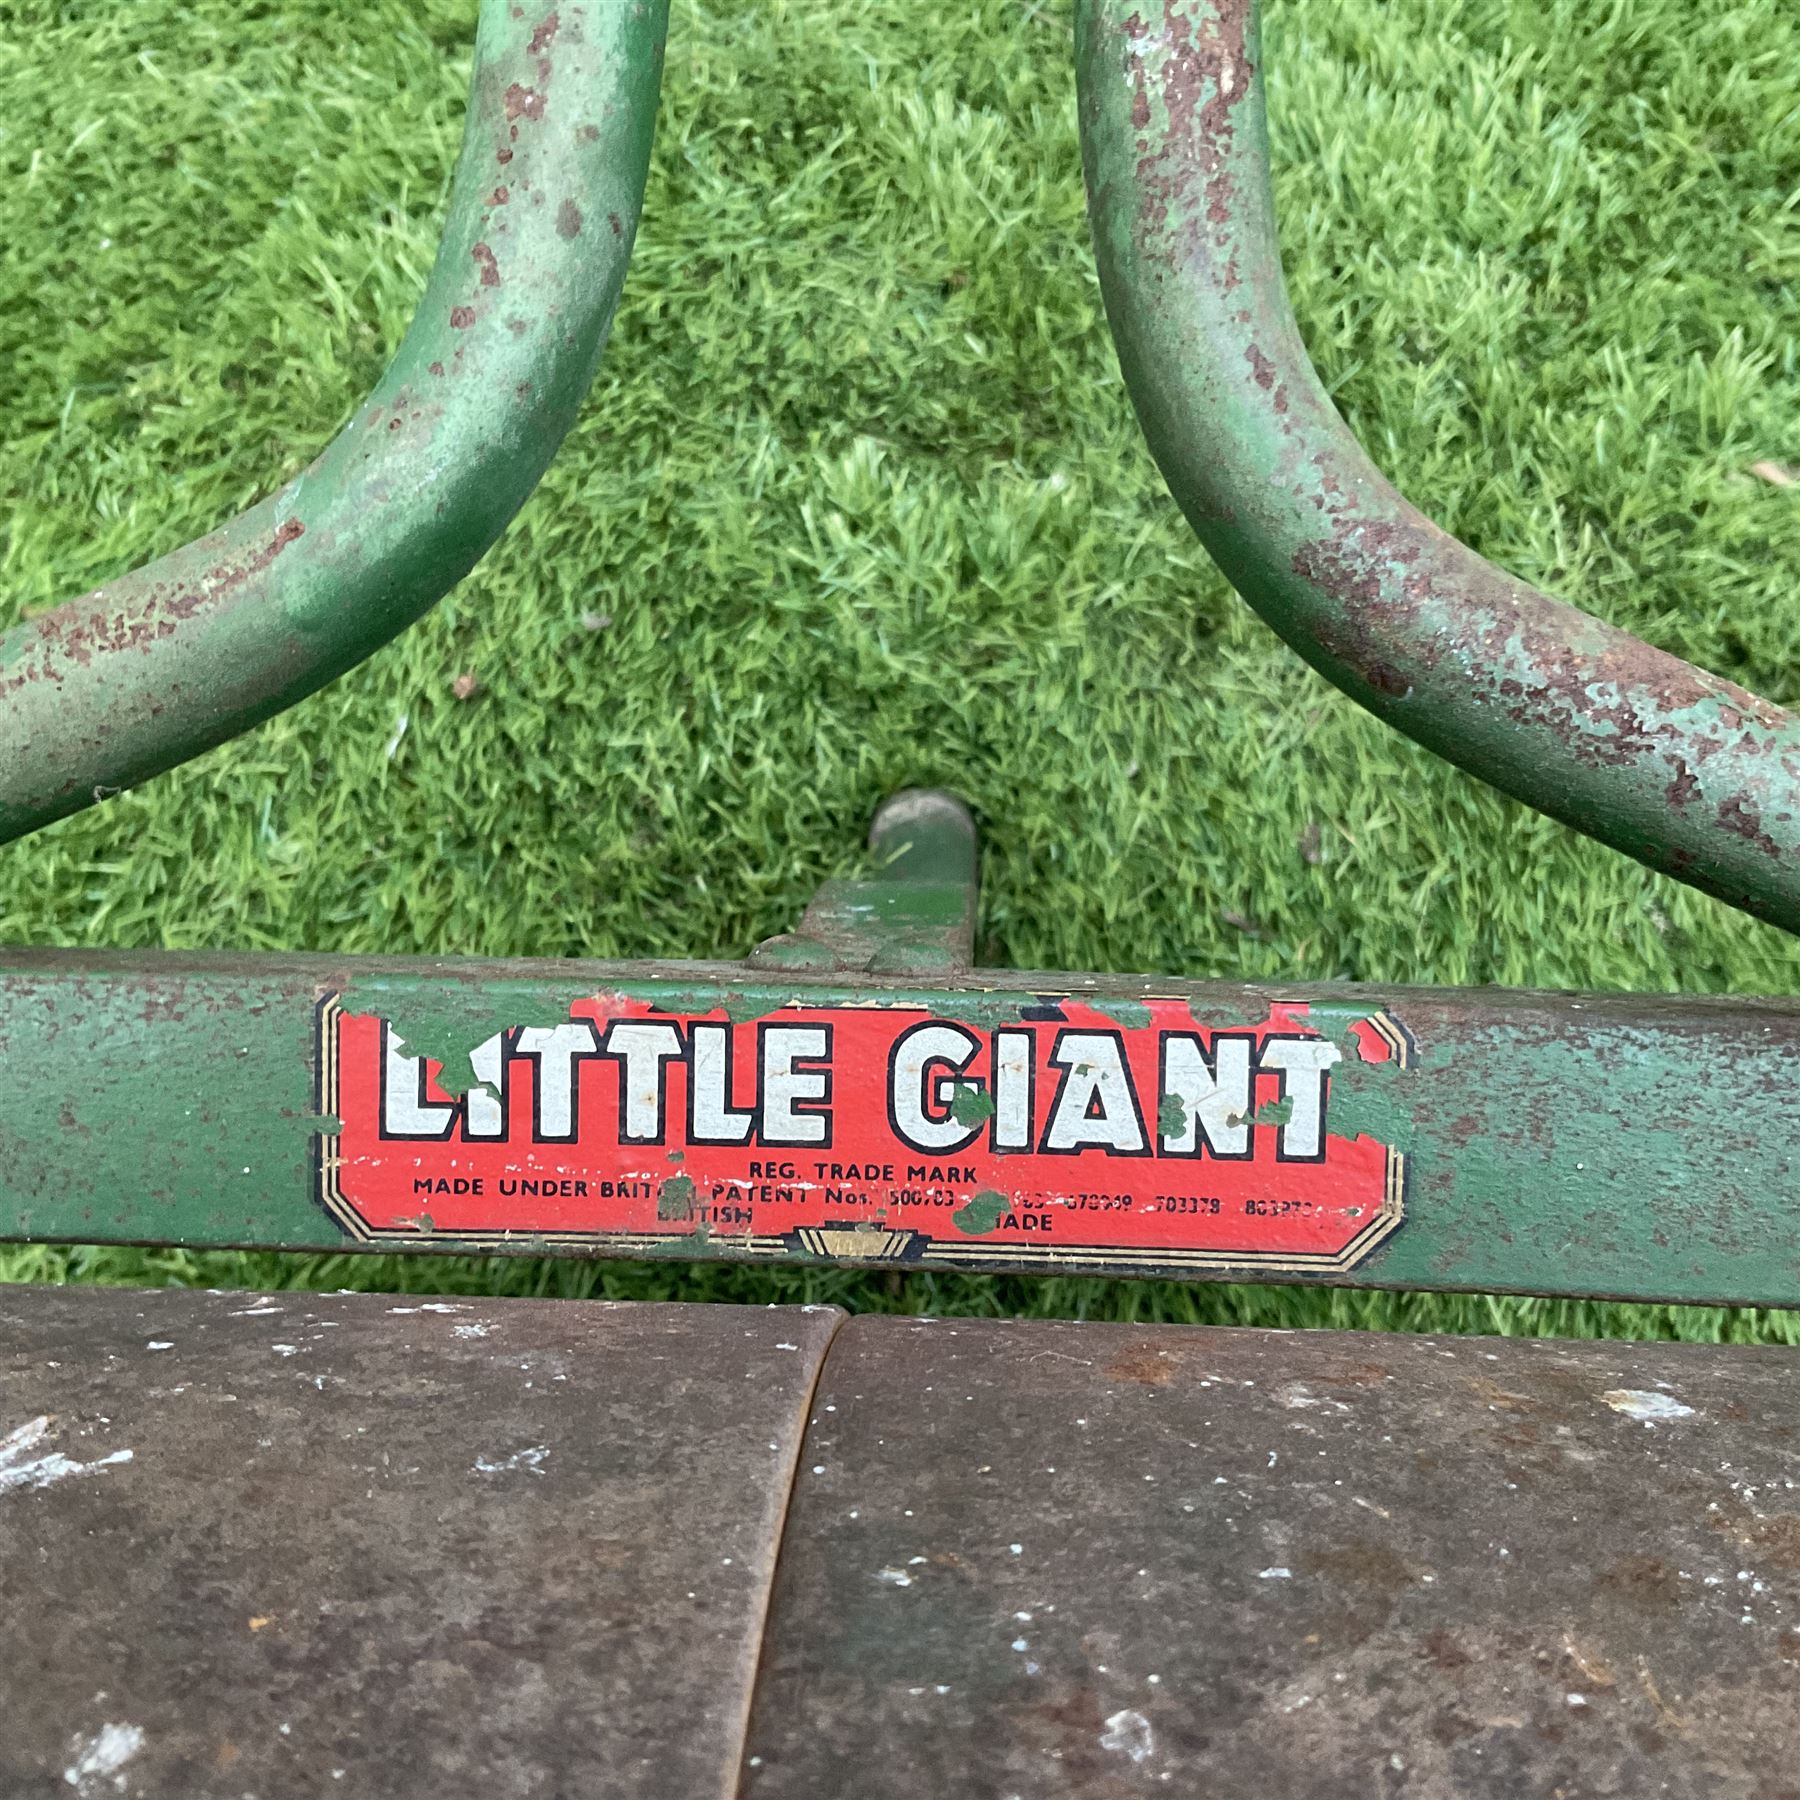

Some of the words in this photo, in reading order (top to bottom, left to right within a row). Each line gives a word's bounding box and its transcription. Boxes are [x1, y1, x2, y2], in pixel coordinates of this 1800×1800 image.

[379, 1018, 834, 1148] LITTLE
[887, 1020, 1341, 1163] GIANT
[749, 1161, 803, 1179] REG.
[814, 1162, 894, 1181] TRADE
[907, 1165, 978, 1184] MARK
[413, 1178, 484, 1195] MADE
[499, 1179, 588, 1198] UNDER
[601, 1181, 696, 1200] BRIT
[712, 1183, 808, 1203] PATENT
[657, 1205, 753, 1223] ITISH
